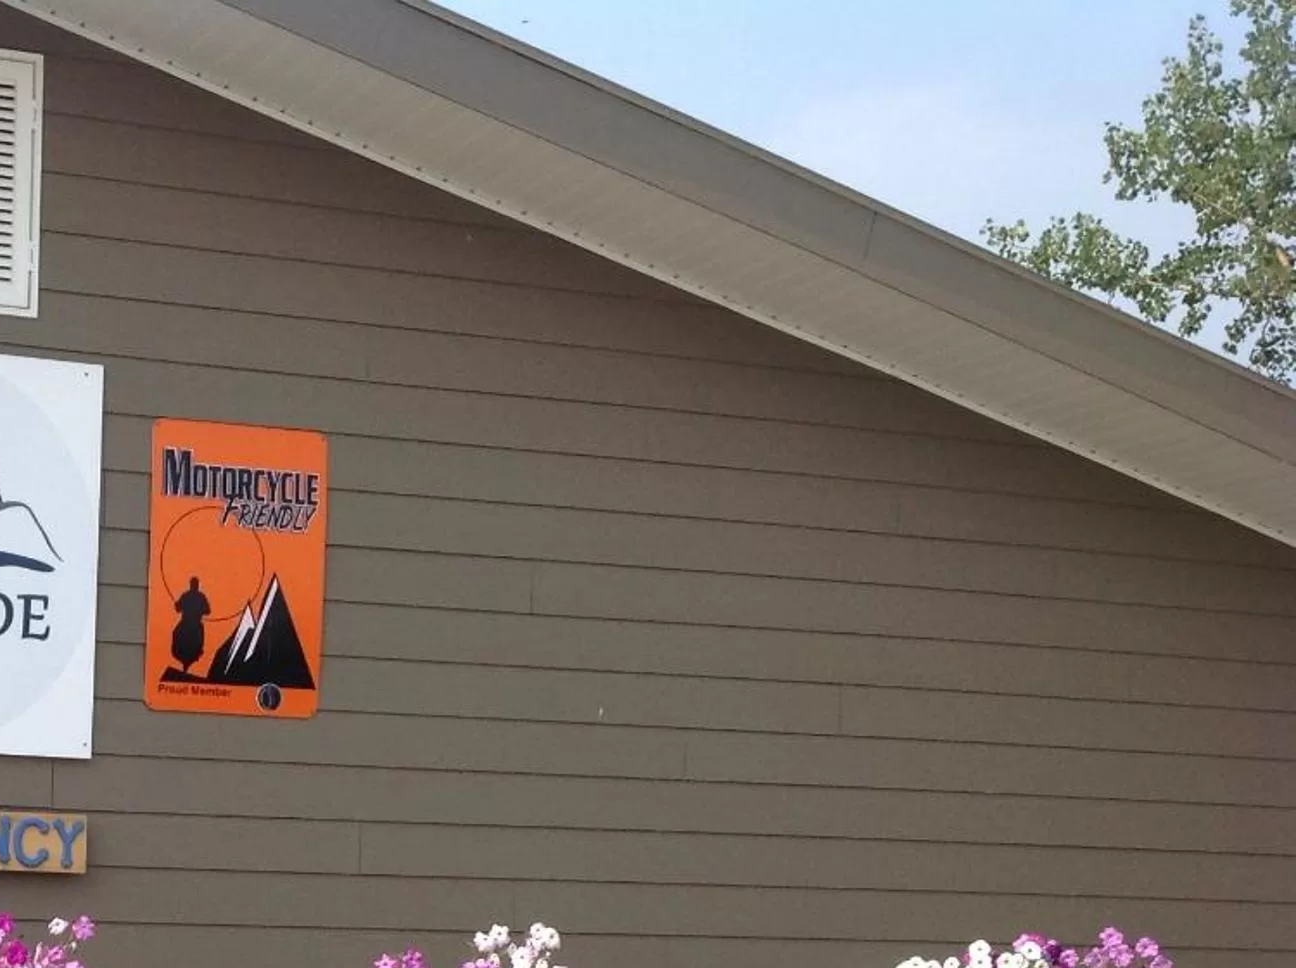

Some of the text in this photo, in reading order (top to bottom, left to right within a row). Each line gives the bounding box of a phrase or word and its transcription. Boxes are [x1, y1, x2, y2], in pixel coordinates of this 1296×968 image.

[163, 447, 320, 506] MOTORCYCLE
[220, 495, 317, 534] FRIENDLY
[158, 683, 232, 698] Proud Member
